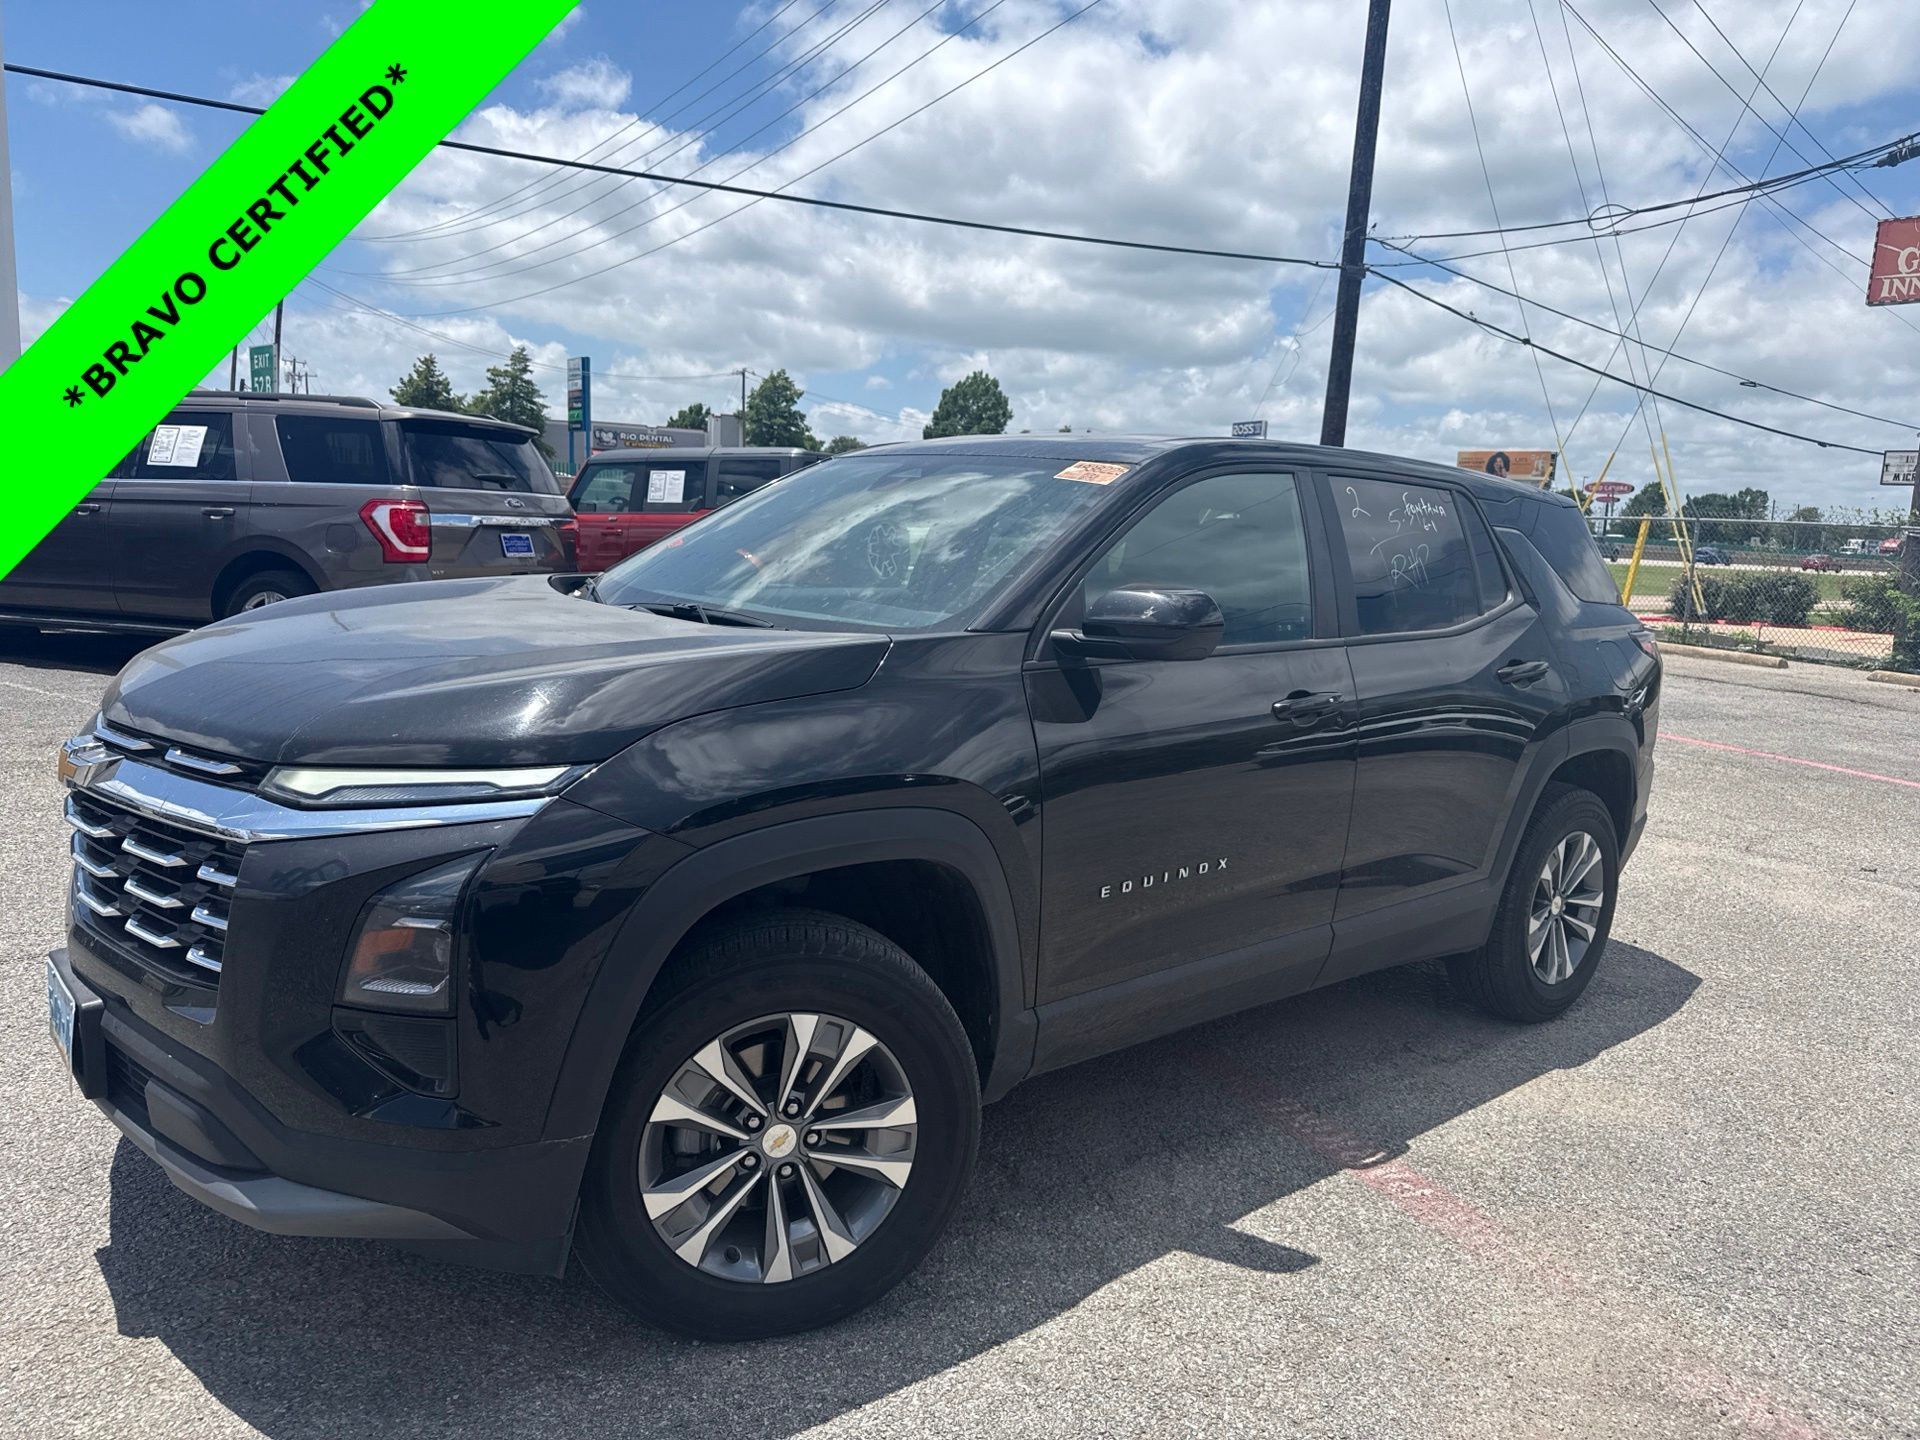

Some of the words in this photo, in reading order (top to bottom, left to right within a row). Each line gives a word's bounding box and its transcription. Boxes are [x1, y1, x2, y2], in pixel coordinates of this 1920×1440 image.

[1253, 352, 1270, 369] EXIT
[1232, 423, 1255, 435] ROSS
[639, 433, 674, 443] DENTAL
[1346, 486, 1371, 518] 2
[1101, 857, 1228, 899] EQUINOX
